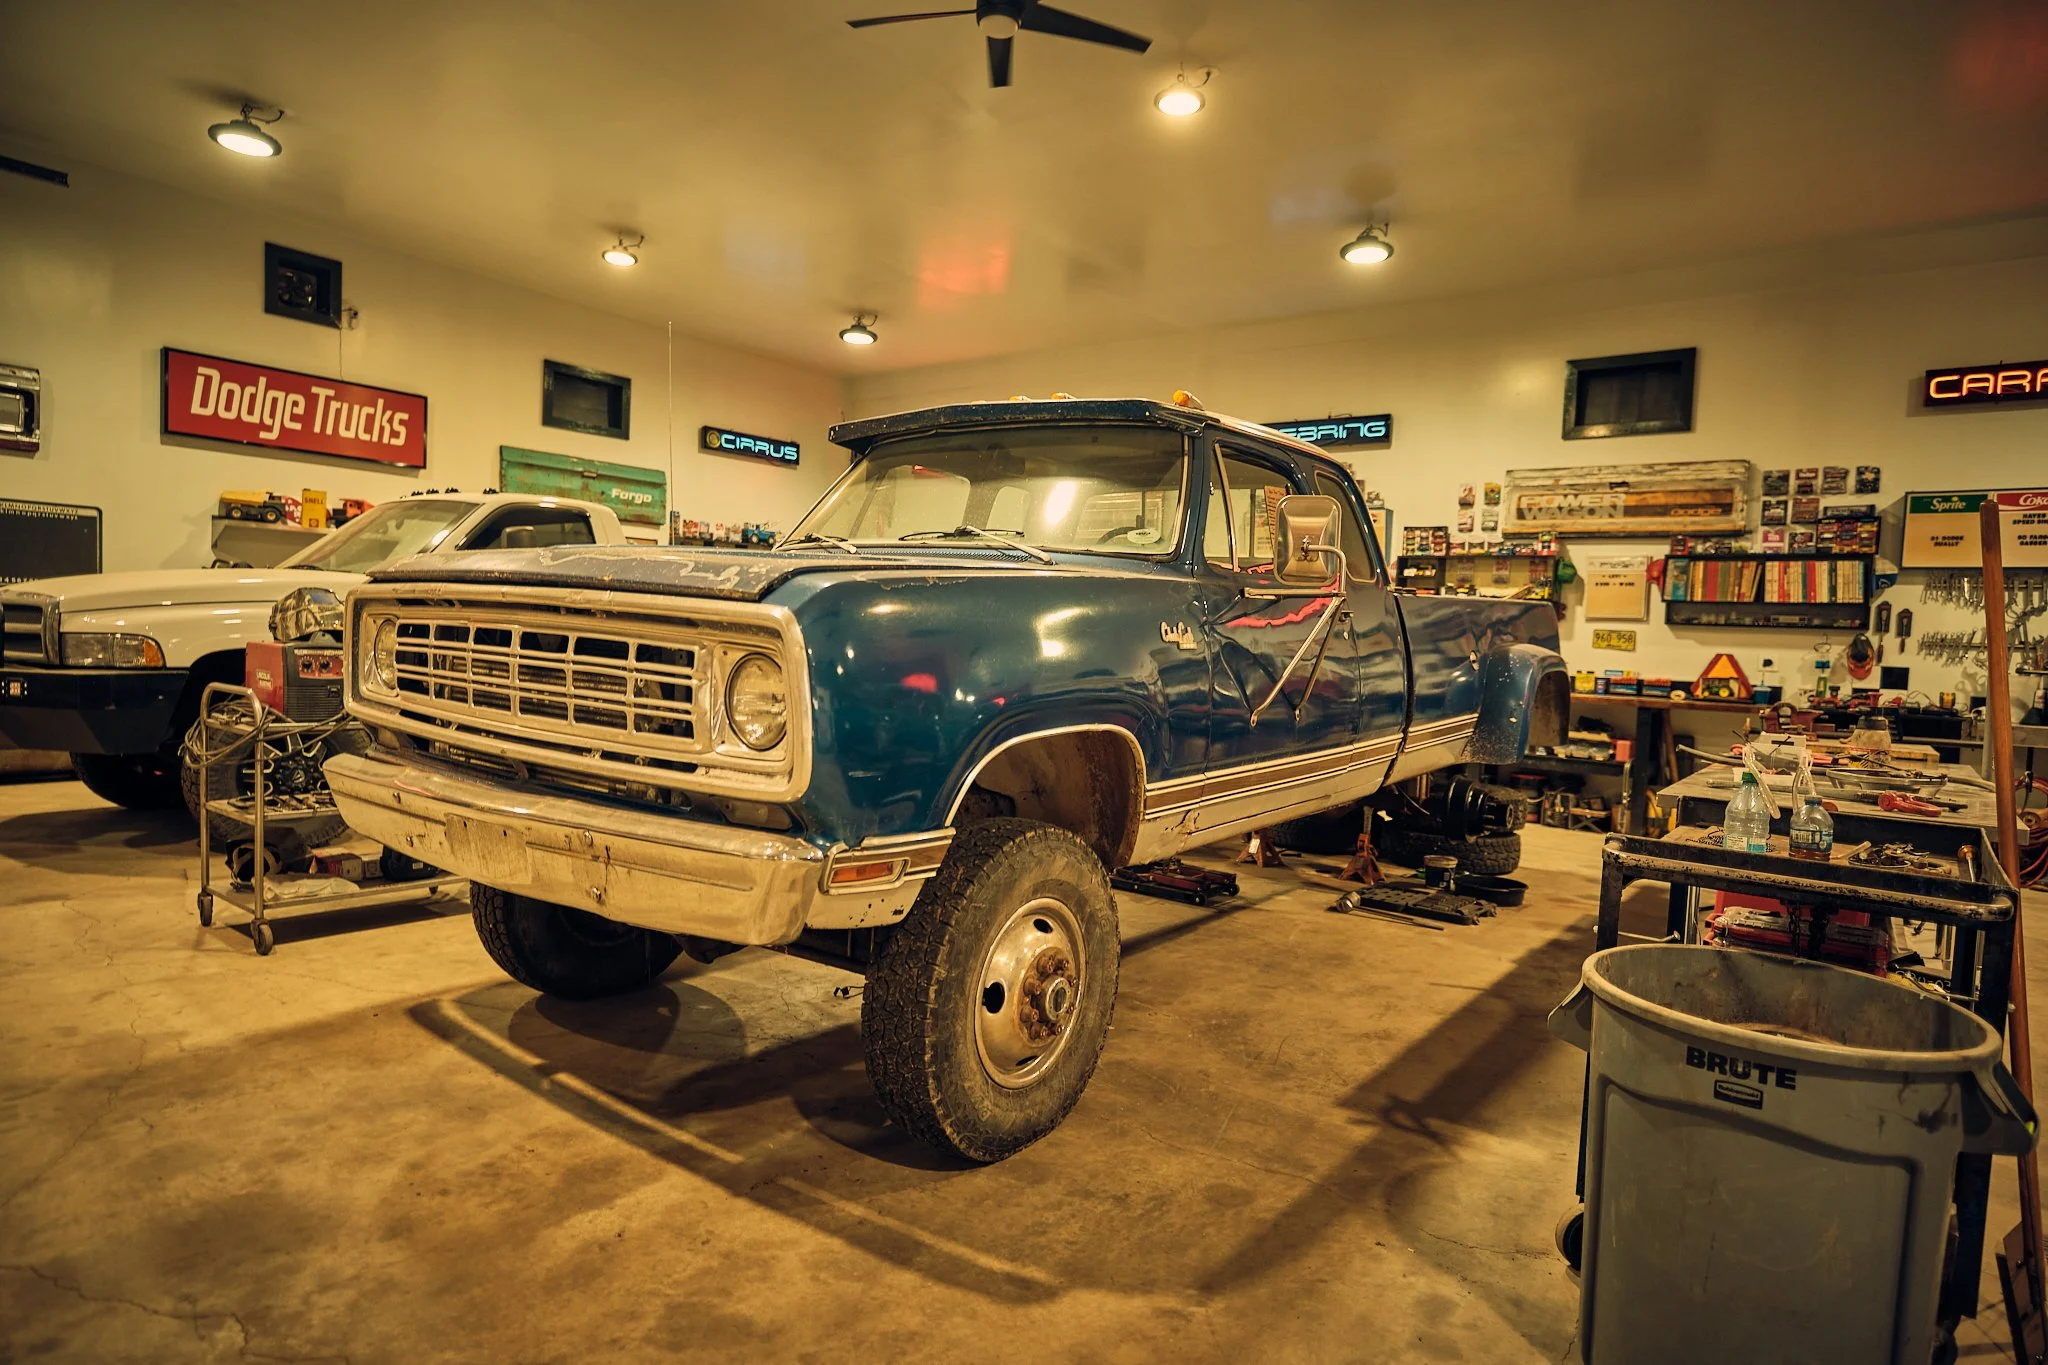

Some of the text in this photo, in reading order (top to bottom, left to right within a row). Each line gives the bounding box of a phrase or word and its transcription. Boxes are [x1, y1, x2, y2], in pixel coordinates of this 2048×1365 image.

[190, 365, 410, 447] Dodge Trucks
[1279, 421, 1386, 442] EBRING
[720, 433, 798, 461] CIRRUS
[611, 487, 653, 505] Fargo
[1519, 493, 1627, 509] POWER
[1930, 497, 1967, 512] Sprite
[1522, 506, 1625, 520] WAGON
[1686, 1045, 1797, 1090] BRUTE
